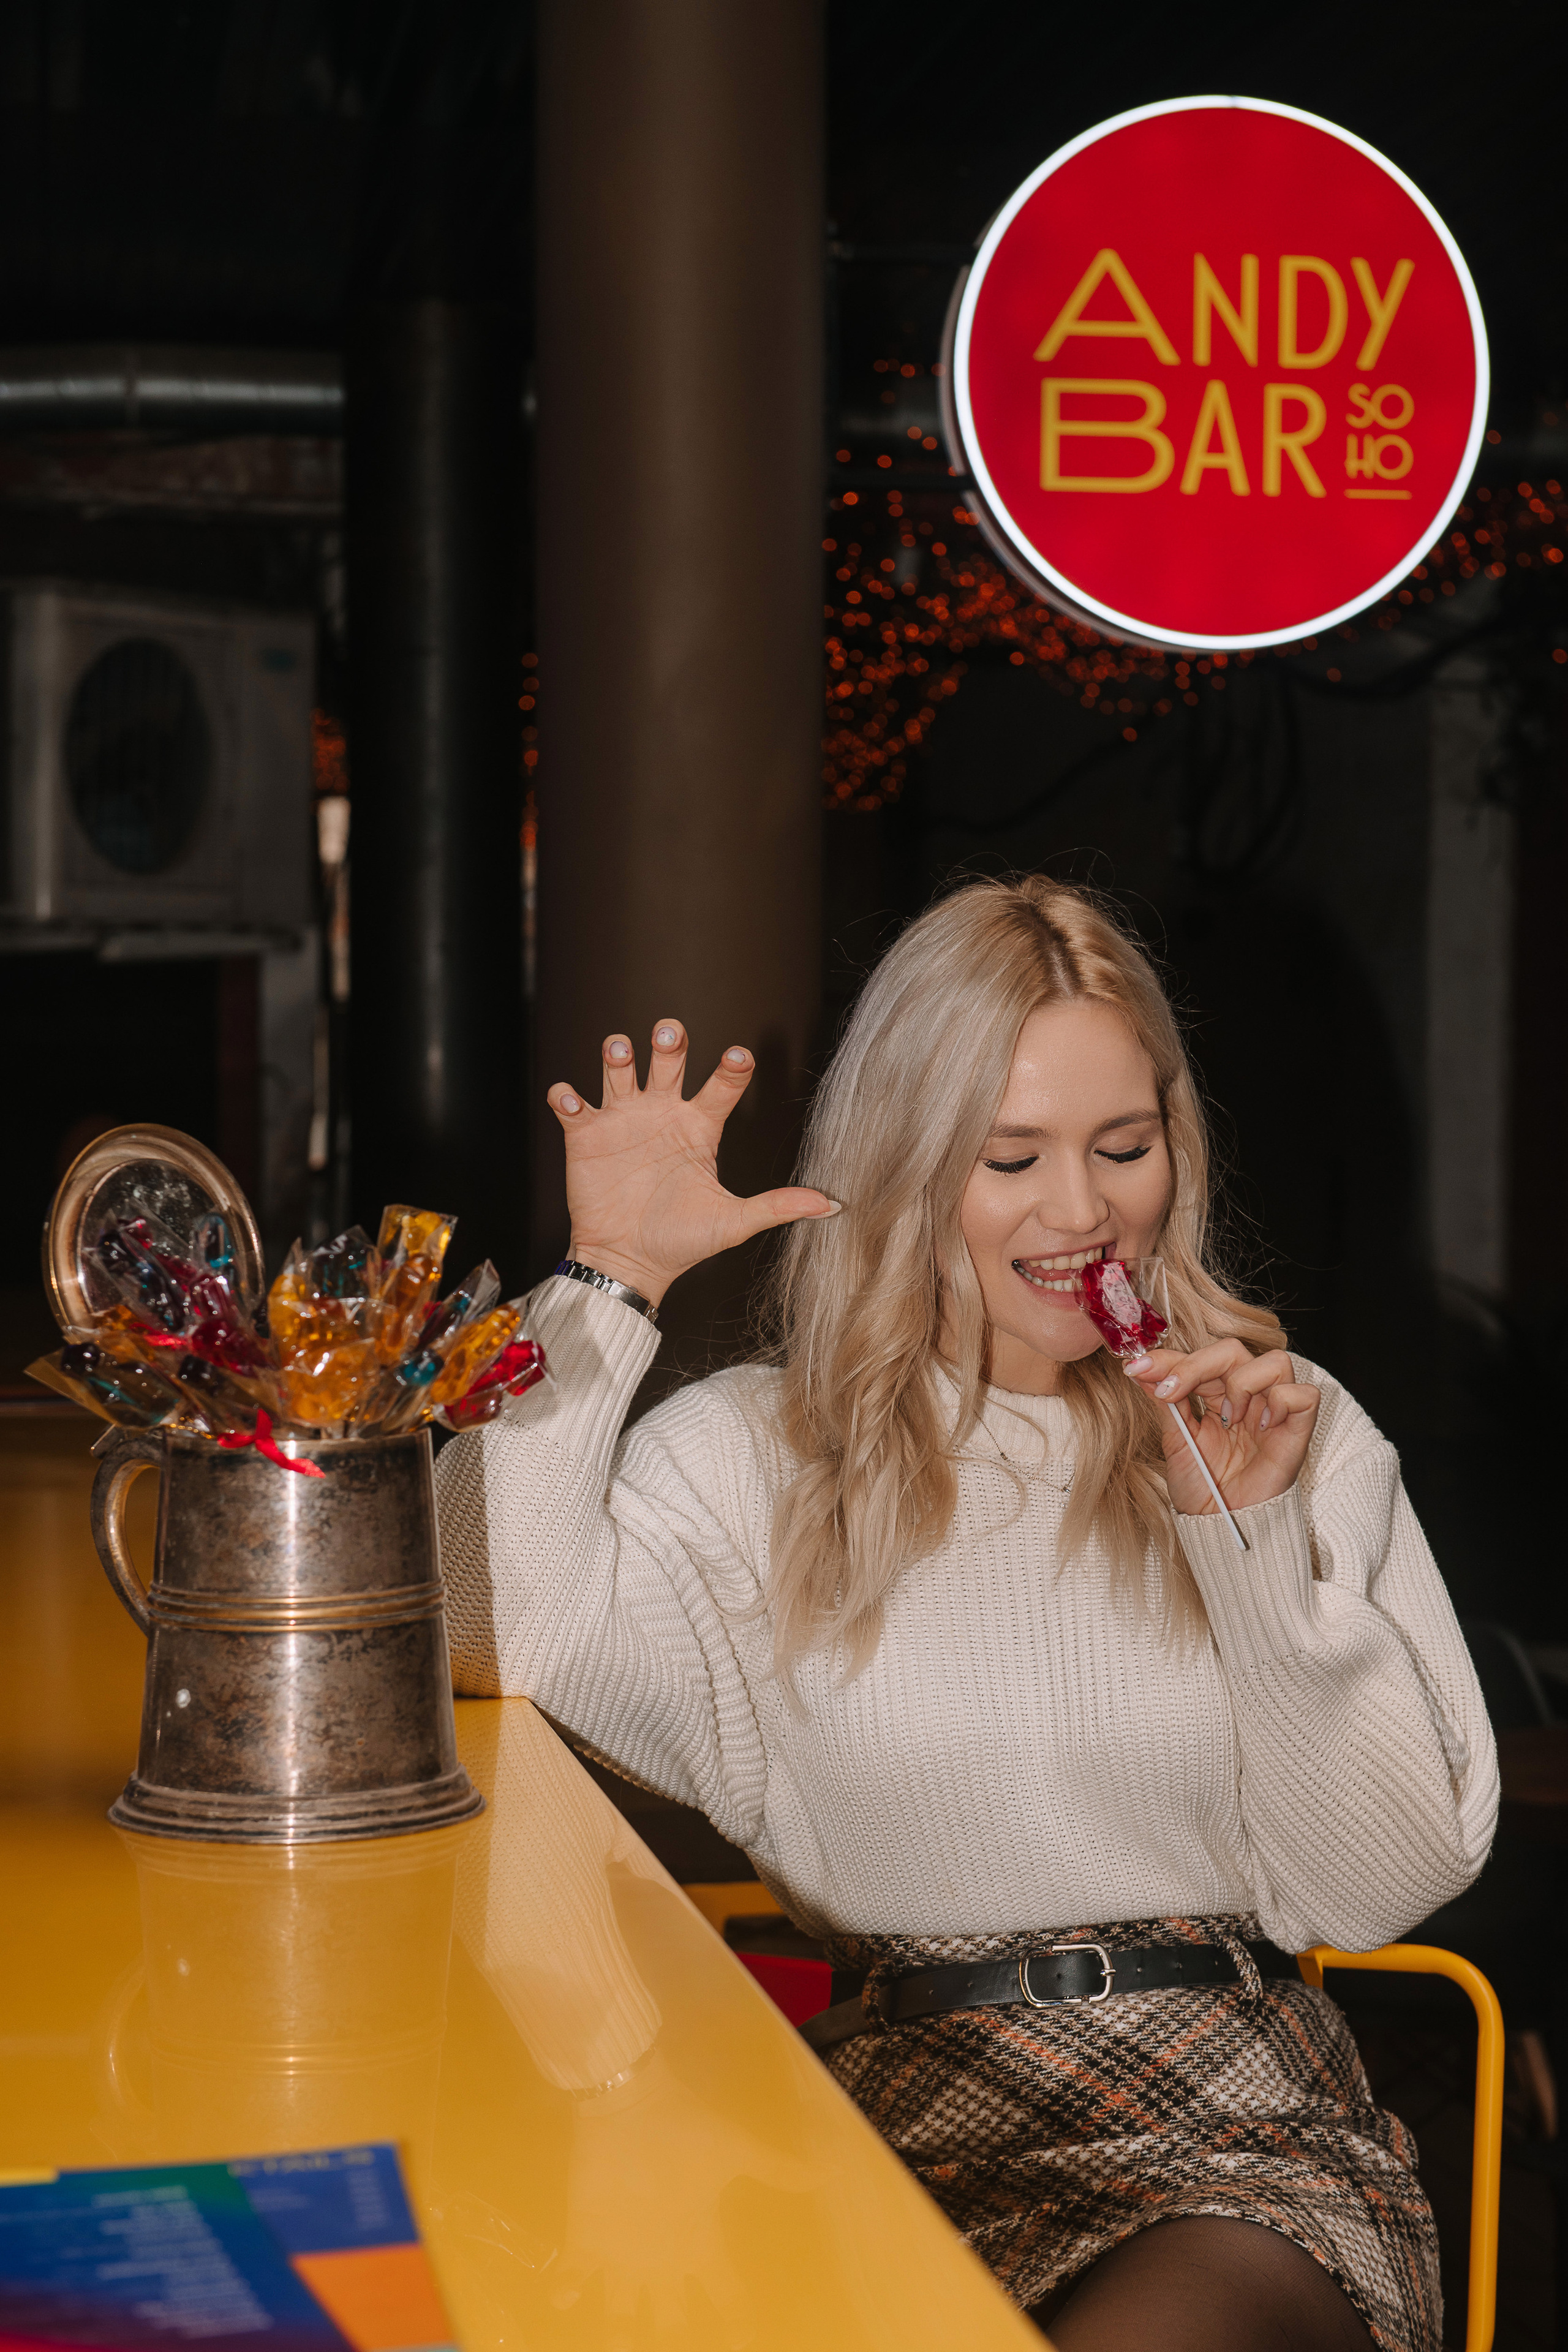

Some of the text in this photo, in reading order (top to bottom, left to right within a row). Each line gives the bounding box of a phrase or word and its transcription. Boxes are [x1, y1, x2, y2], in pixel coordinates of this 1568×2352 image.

[1034, 249, 1414, 371] ANDY
[1040, 378, 1327, 497] BAR
[1346, 383, 1414, 429] SO
